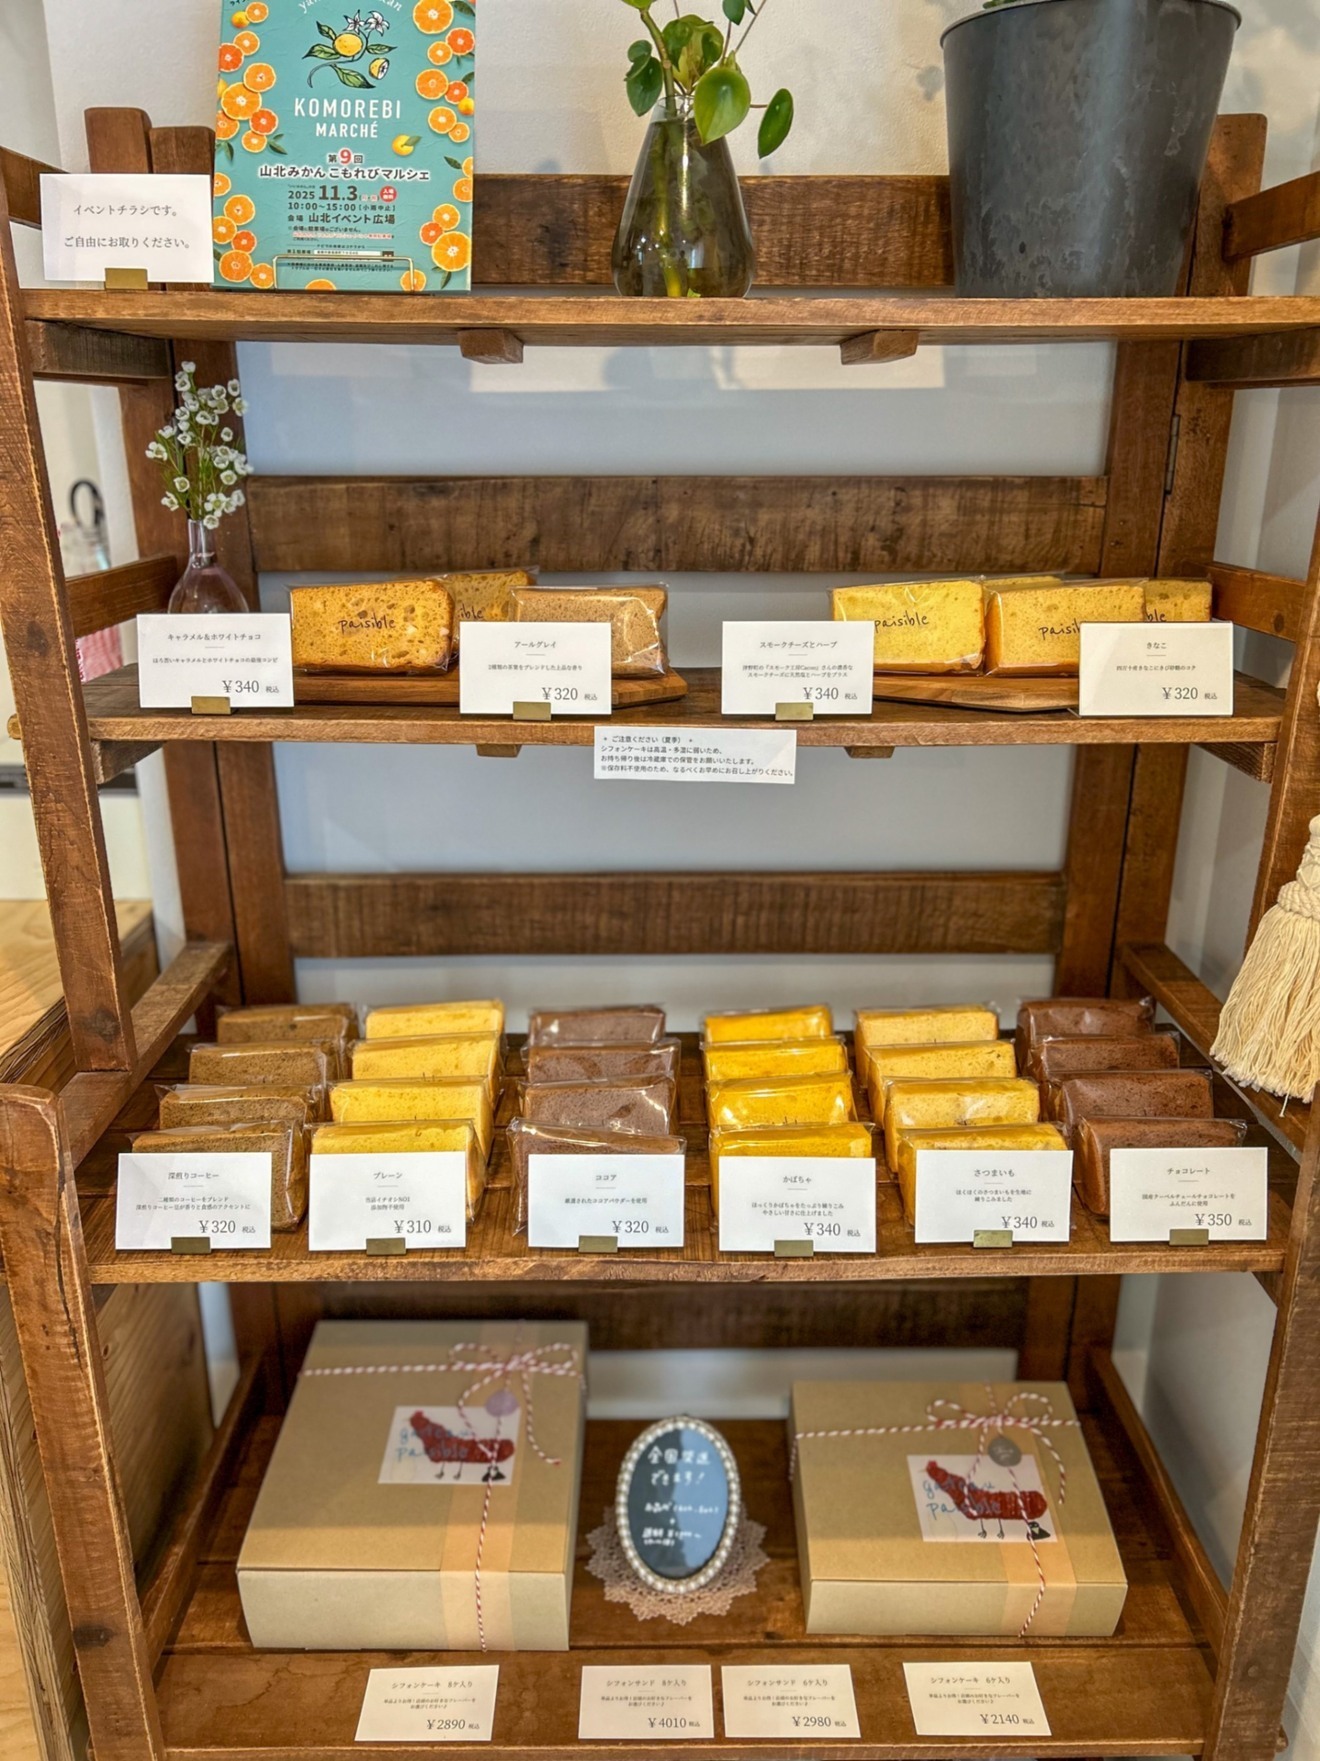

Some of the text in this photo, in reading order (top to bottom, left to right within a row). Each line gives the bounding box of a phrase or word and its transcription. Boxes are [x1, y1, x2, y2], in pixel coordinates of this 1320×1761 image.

[294, 98, 400, 119] KOMOREBI
[315, 122, 378, 138] MARCHÉ
[328, 149, 364, 164] 第9回
[288, 190, 316, 200] 2025
[318, 185, 358, 201] 11.3
[73, 204, 178, 217] イベントチラシです。
[308, 213, 396, 225] 山北イベント広場
[64, 236, 190, 249] ご自由にお取りください。
[337, 611, 397, 636] paisible
[874, 609, 930, 634] paisible
[513, 641, 557, 649] アールグレイ
[759, 641, 838, 649] スモークチーズとハーブ
[221, 679, 260, 694] ¥340
[1161, 686, 1199, 700] ¥320
[541, 687, 579, 701] ¥320
[803, 687, 839, 700] ¥340
[168, 1171, 220, 1180] 深煎りコーヒー
[373, 1171, 403, 1180] プレーン
[973, 1169, 1015, 1178] さつまいも
[1166, 1167, 1210, 1175] チョコレート
[783, 1175, 812, 1184] かぼちゃ
[1001, 1215, 1038, 1229] ¥340
[1194, 1213, 1232, 1226] ¥350
[198, 1220, 236, 1234] ¥320
[394, 1219, 432, 1234] ¥310
[612, 1220, 650, 1234] ¥320
[803, 1222, 841, 1237] ¥340
[391, 1681, 441, 1690] シフォンケーキ
[606, 1679, 655, 1687] シフォンサンド
[747, 1679, 796, 1687] シフォンサンド
[426, 1718, 466, 1730] ¥2890
[648, 1717, 687, 1729] ¥4010
[792, 1716, 832, 1728] ¥2980
[979, 1713, 1020, 1725] ¥2140
